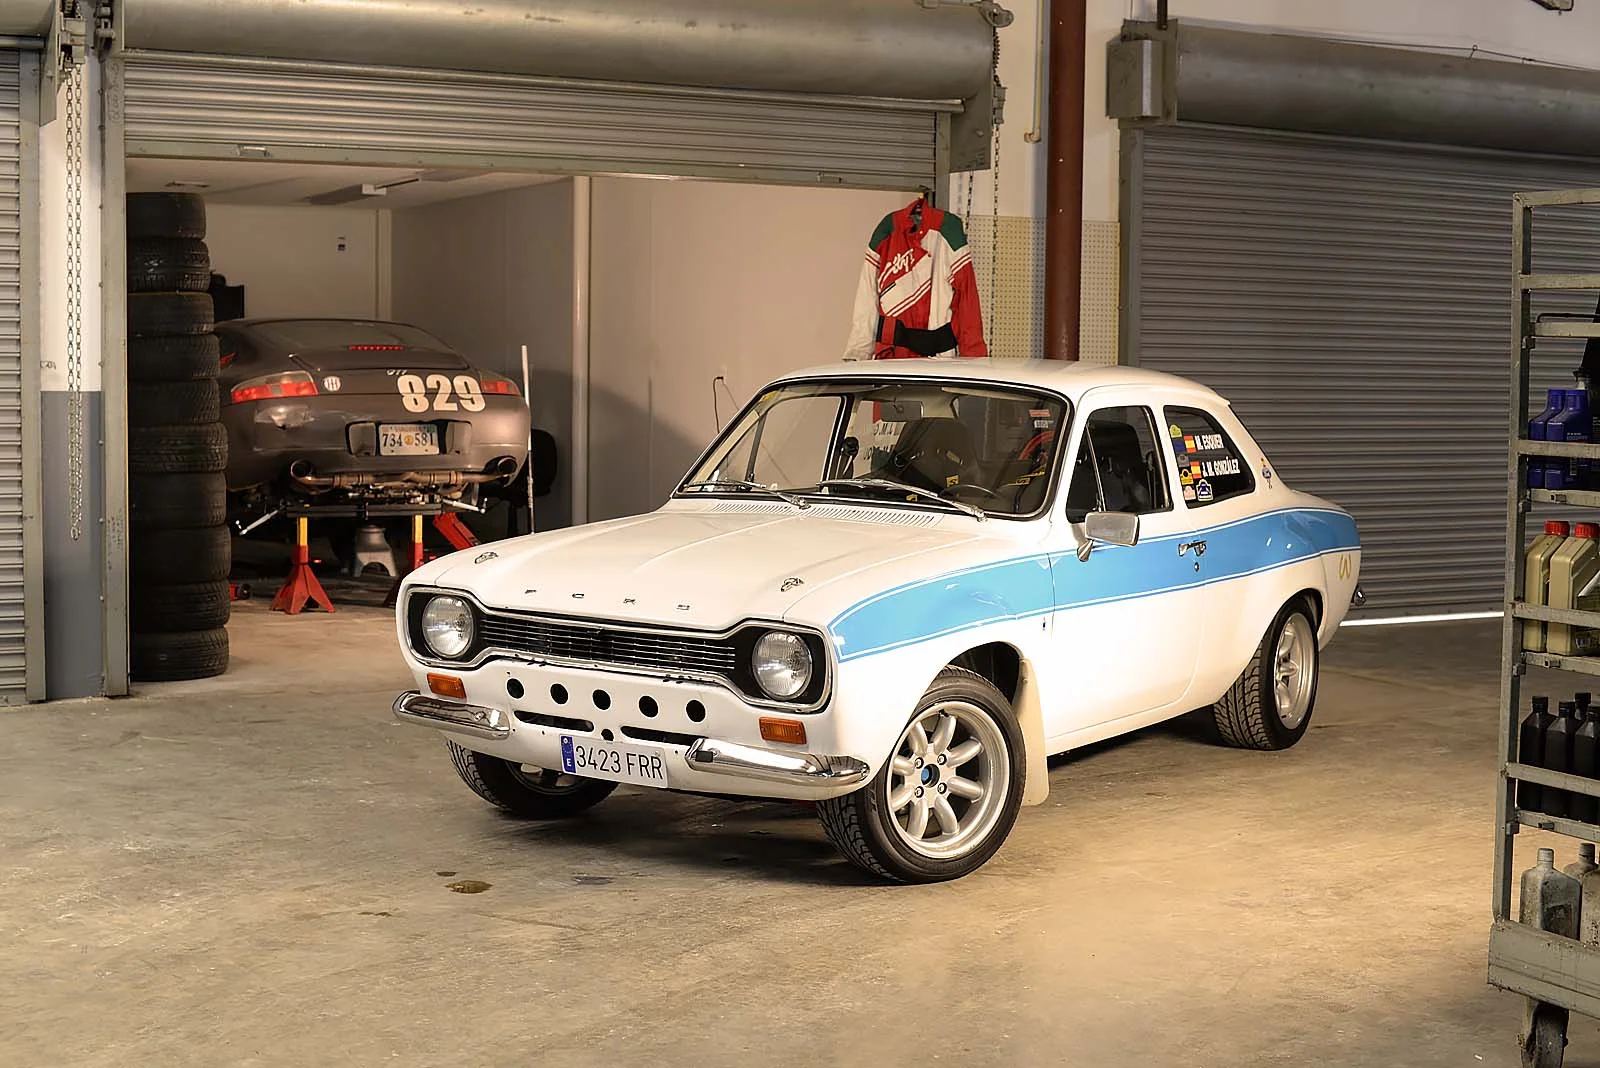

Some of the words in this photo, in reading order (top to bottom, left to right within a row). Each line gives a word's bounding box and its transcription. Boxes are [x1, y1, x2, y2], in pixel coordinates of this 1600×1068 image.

[397, 374, 486, 412] 829
[382, 434, 403, 447] 734
[415, 433, 434, 446] 581
[566, 758, 572, 767] E
[576, 746, 621, 773] 3423
[626, 753, 663, 779] FRR
